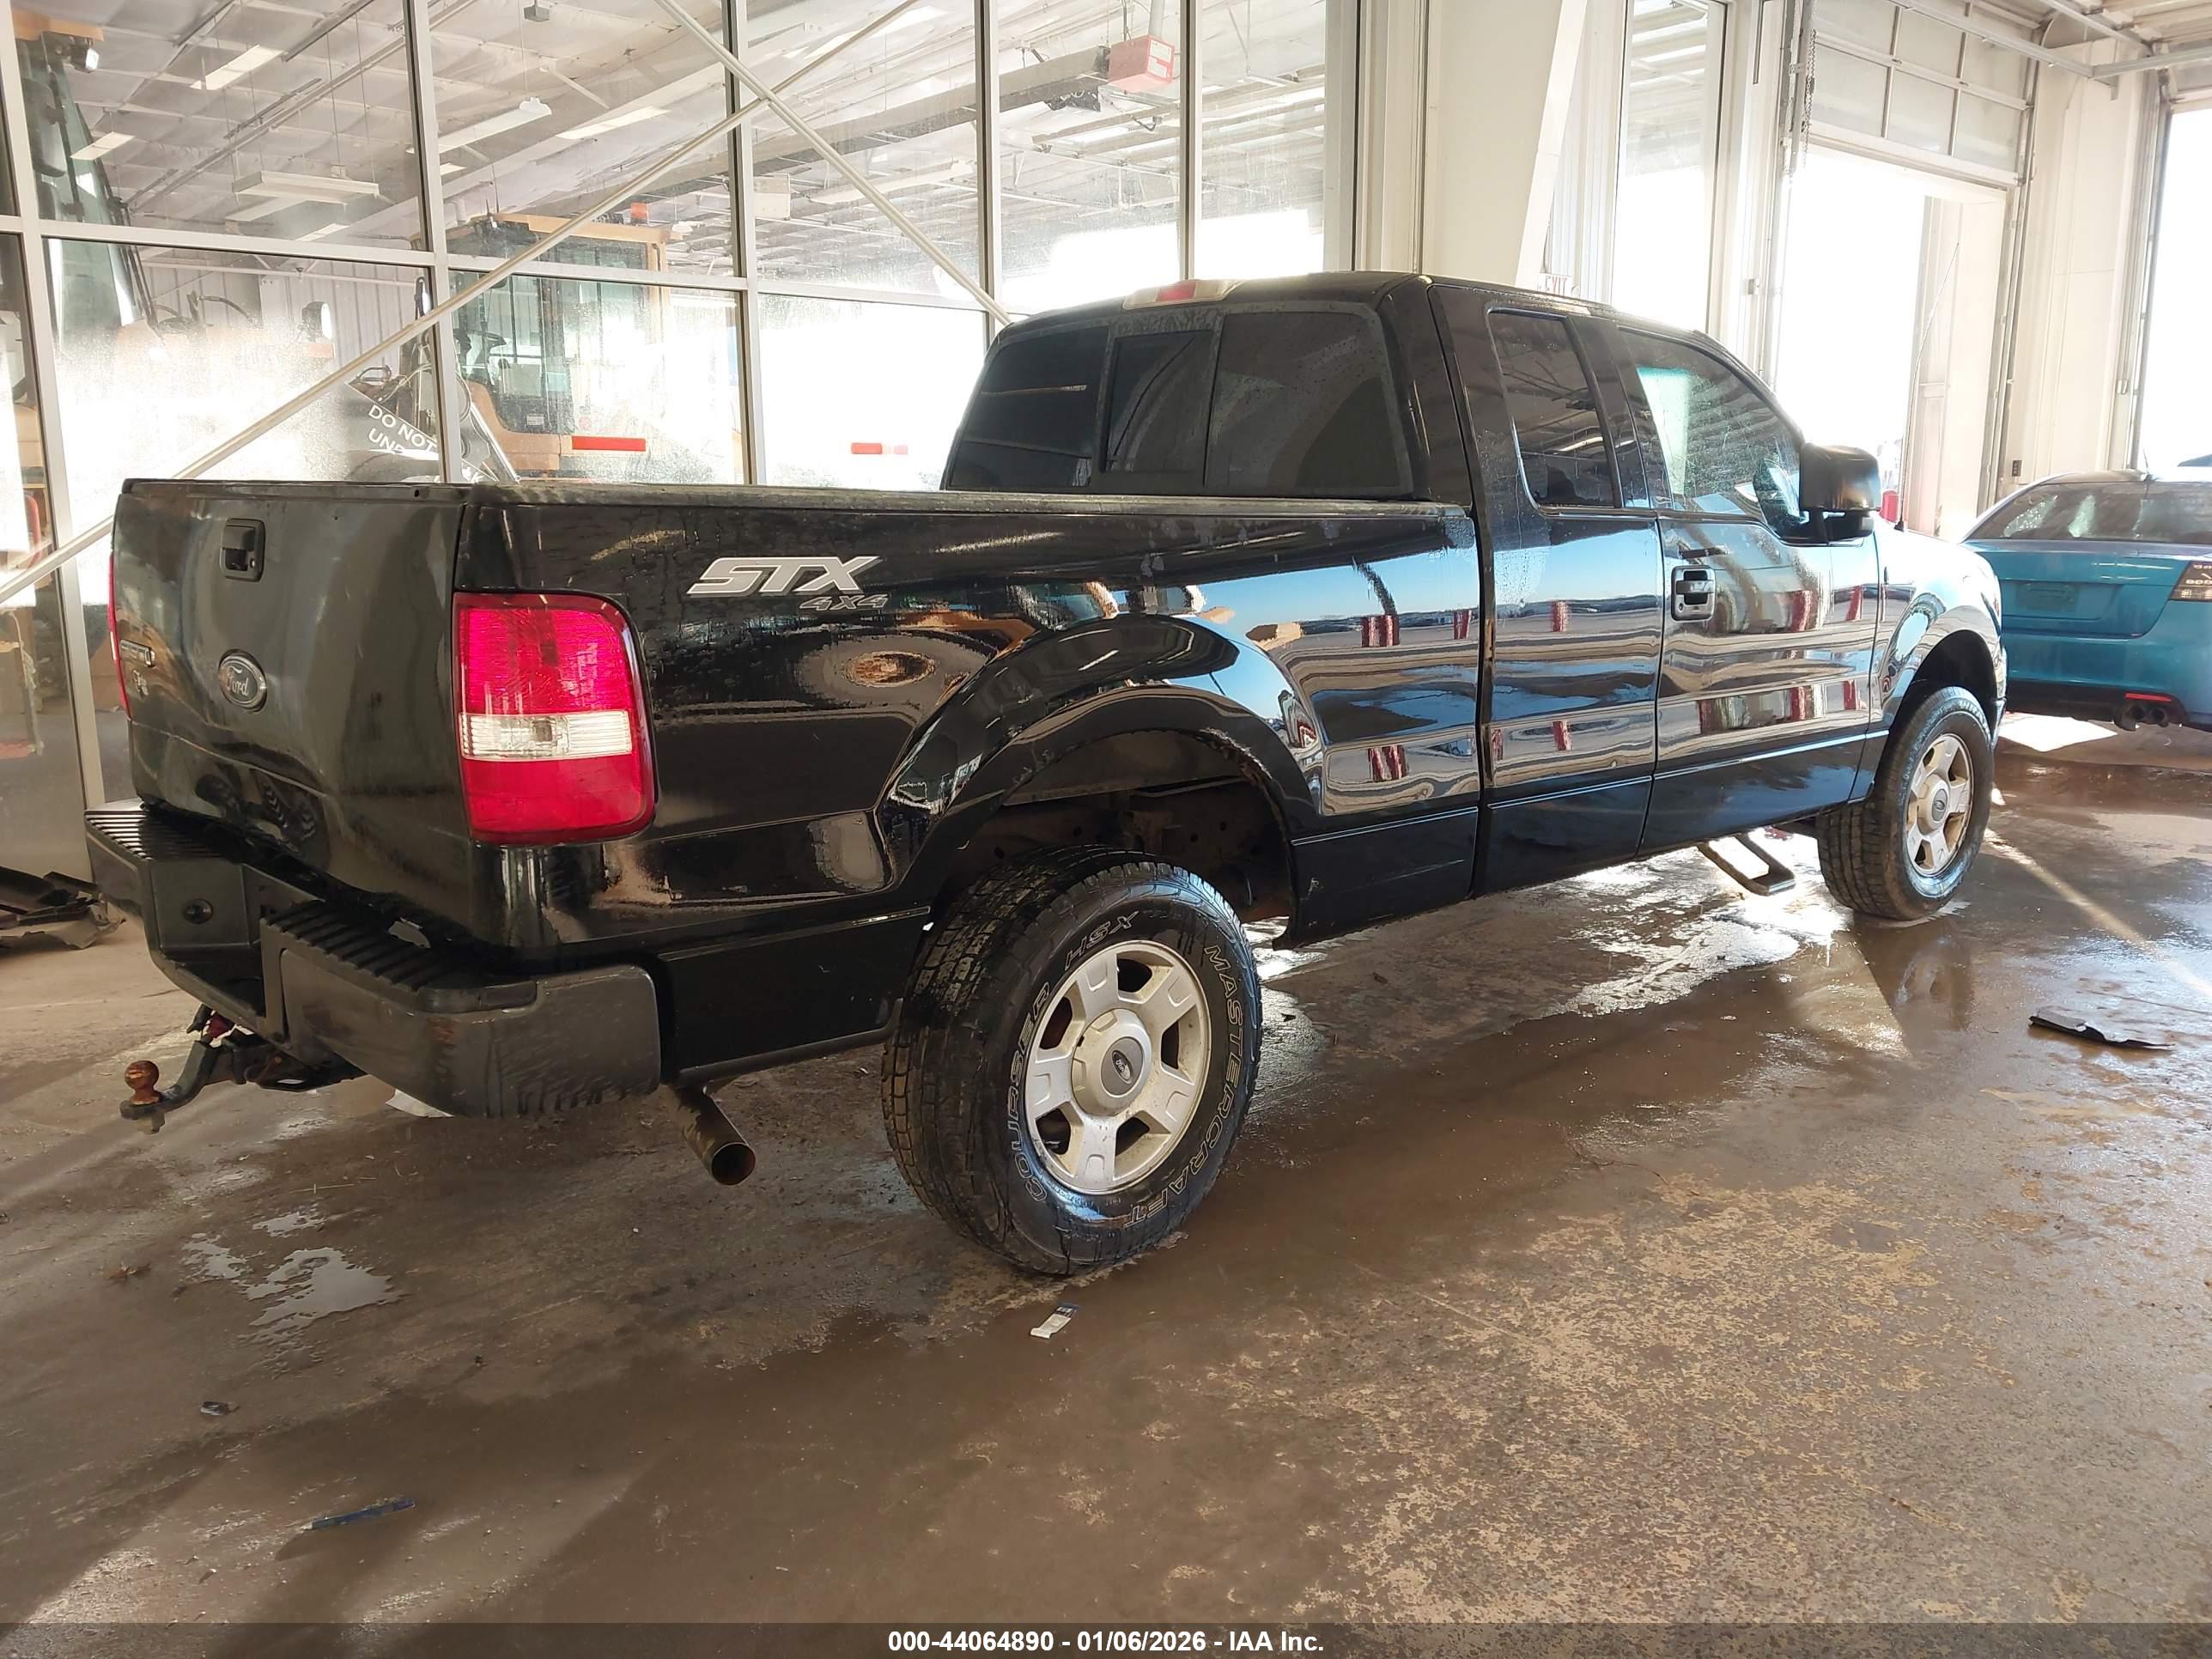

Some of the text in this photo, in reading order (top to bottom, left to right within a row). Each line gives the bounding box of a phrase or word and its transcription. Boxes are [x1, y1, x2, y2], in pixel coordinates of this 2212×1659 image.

[368, 404, 397, 428] DO
[687, 556, 881, 595] STX
[1006, 910, 1139, 1202] COURSER HSX
[1125, 945, 1243, 1228] MASTERCRAFT
